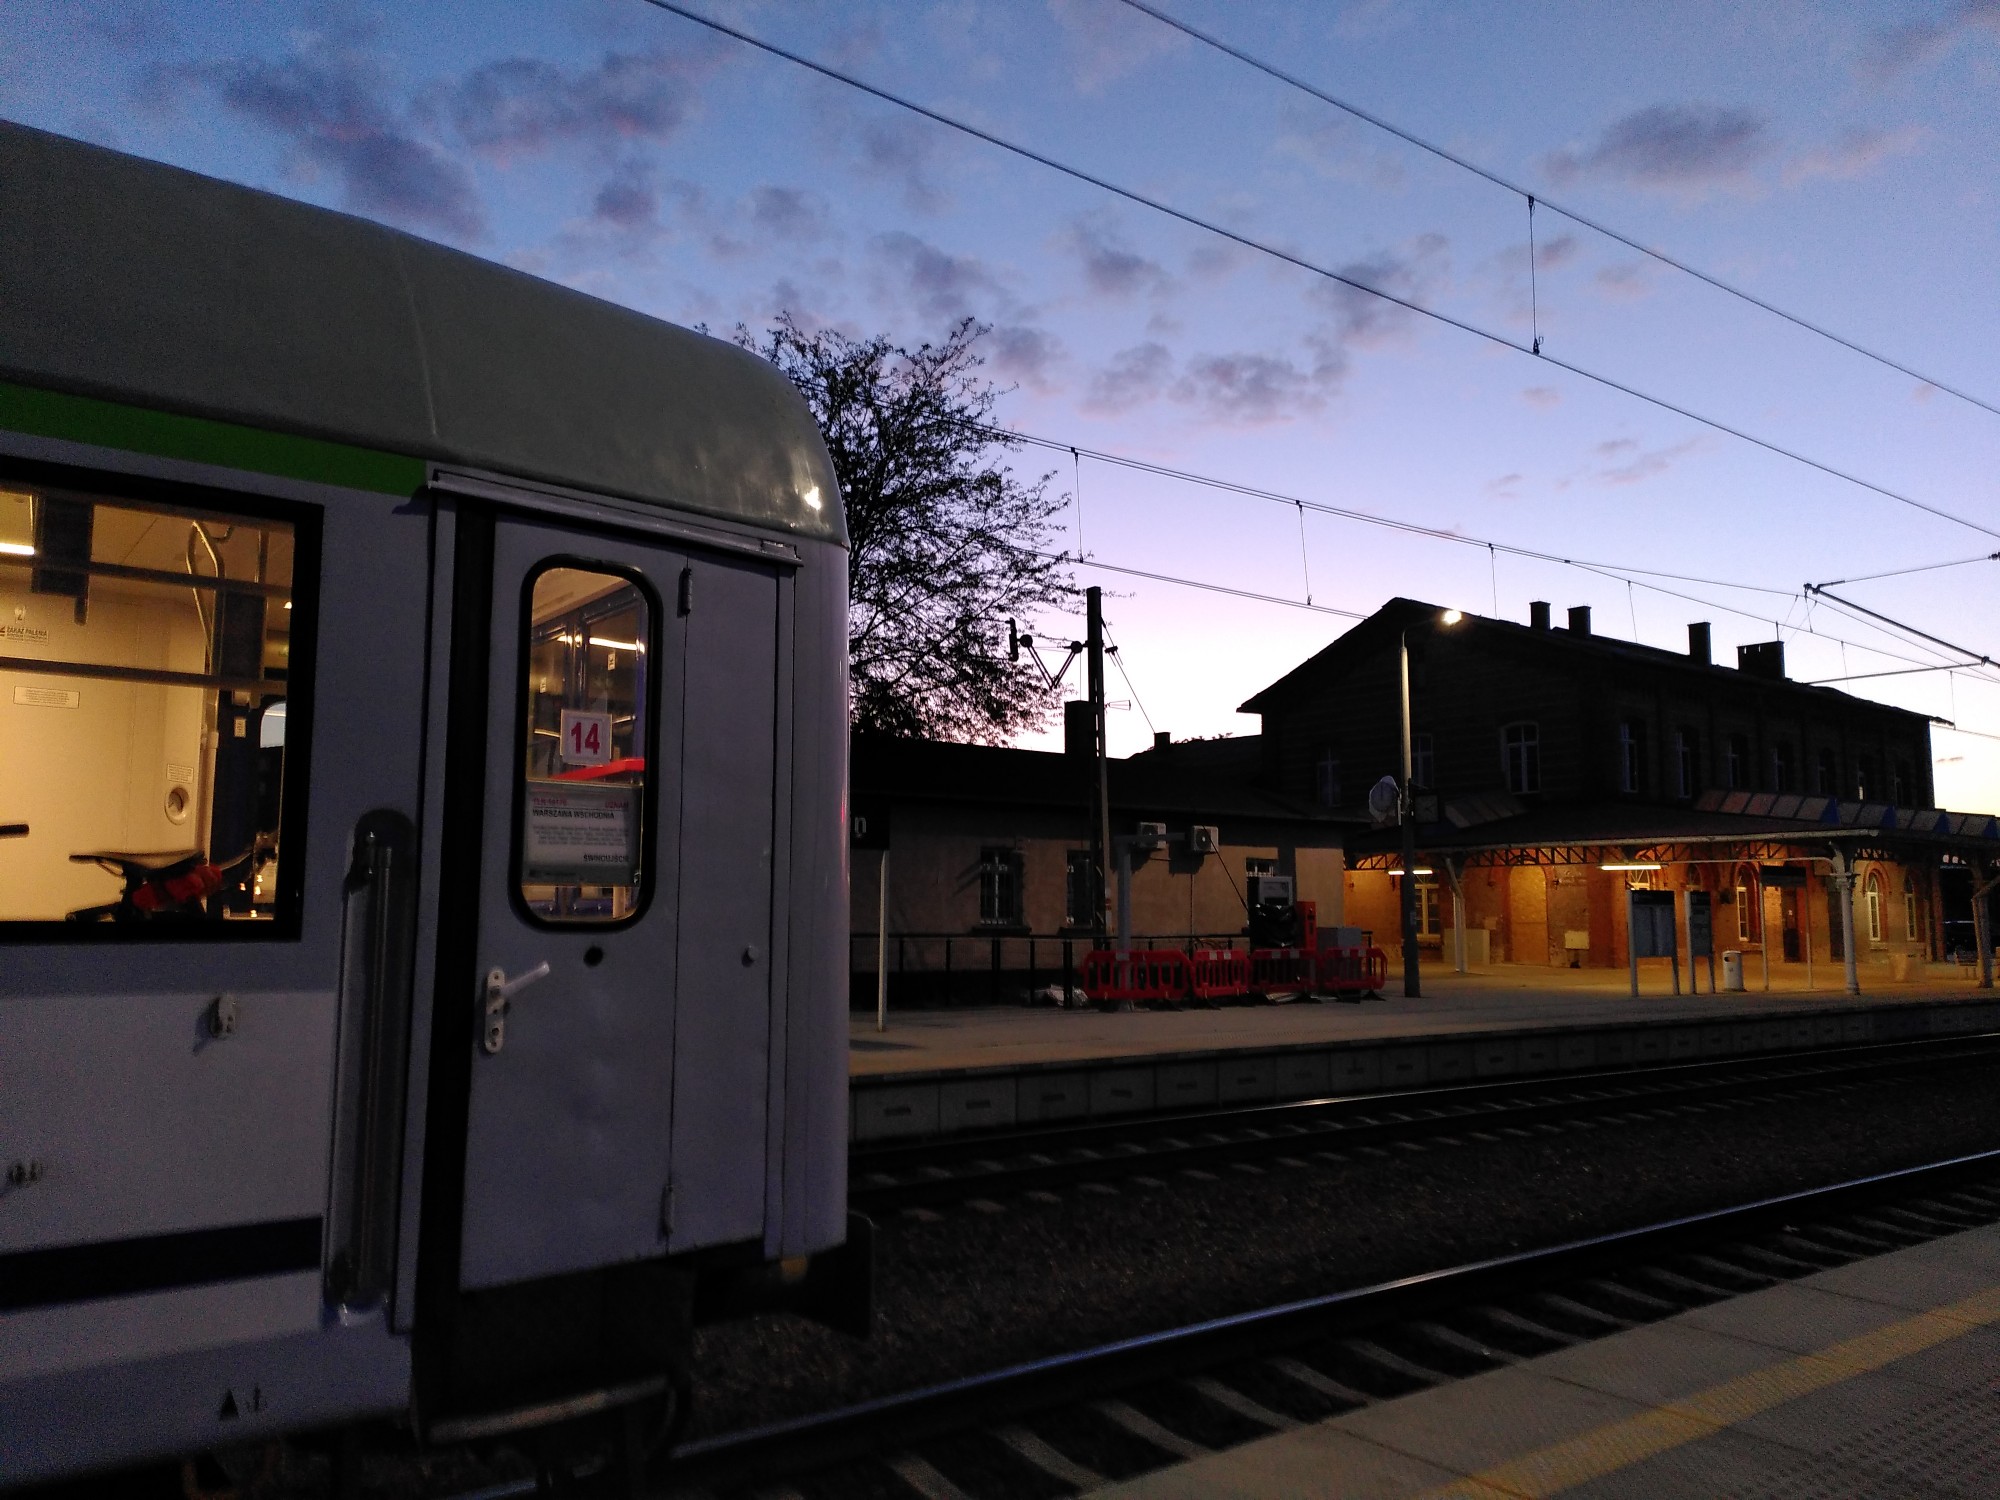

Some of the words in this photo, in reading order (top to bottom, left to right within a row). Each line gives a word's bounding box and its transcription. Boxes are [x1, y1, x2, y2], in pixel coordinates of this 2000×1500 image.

[571, 721, 600, 754] 14
[532, 809, 572, 818] WARSZAWA
[573, 810, 614, 819] WSCHODNIA
